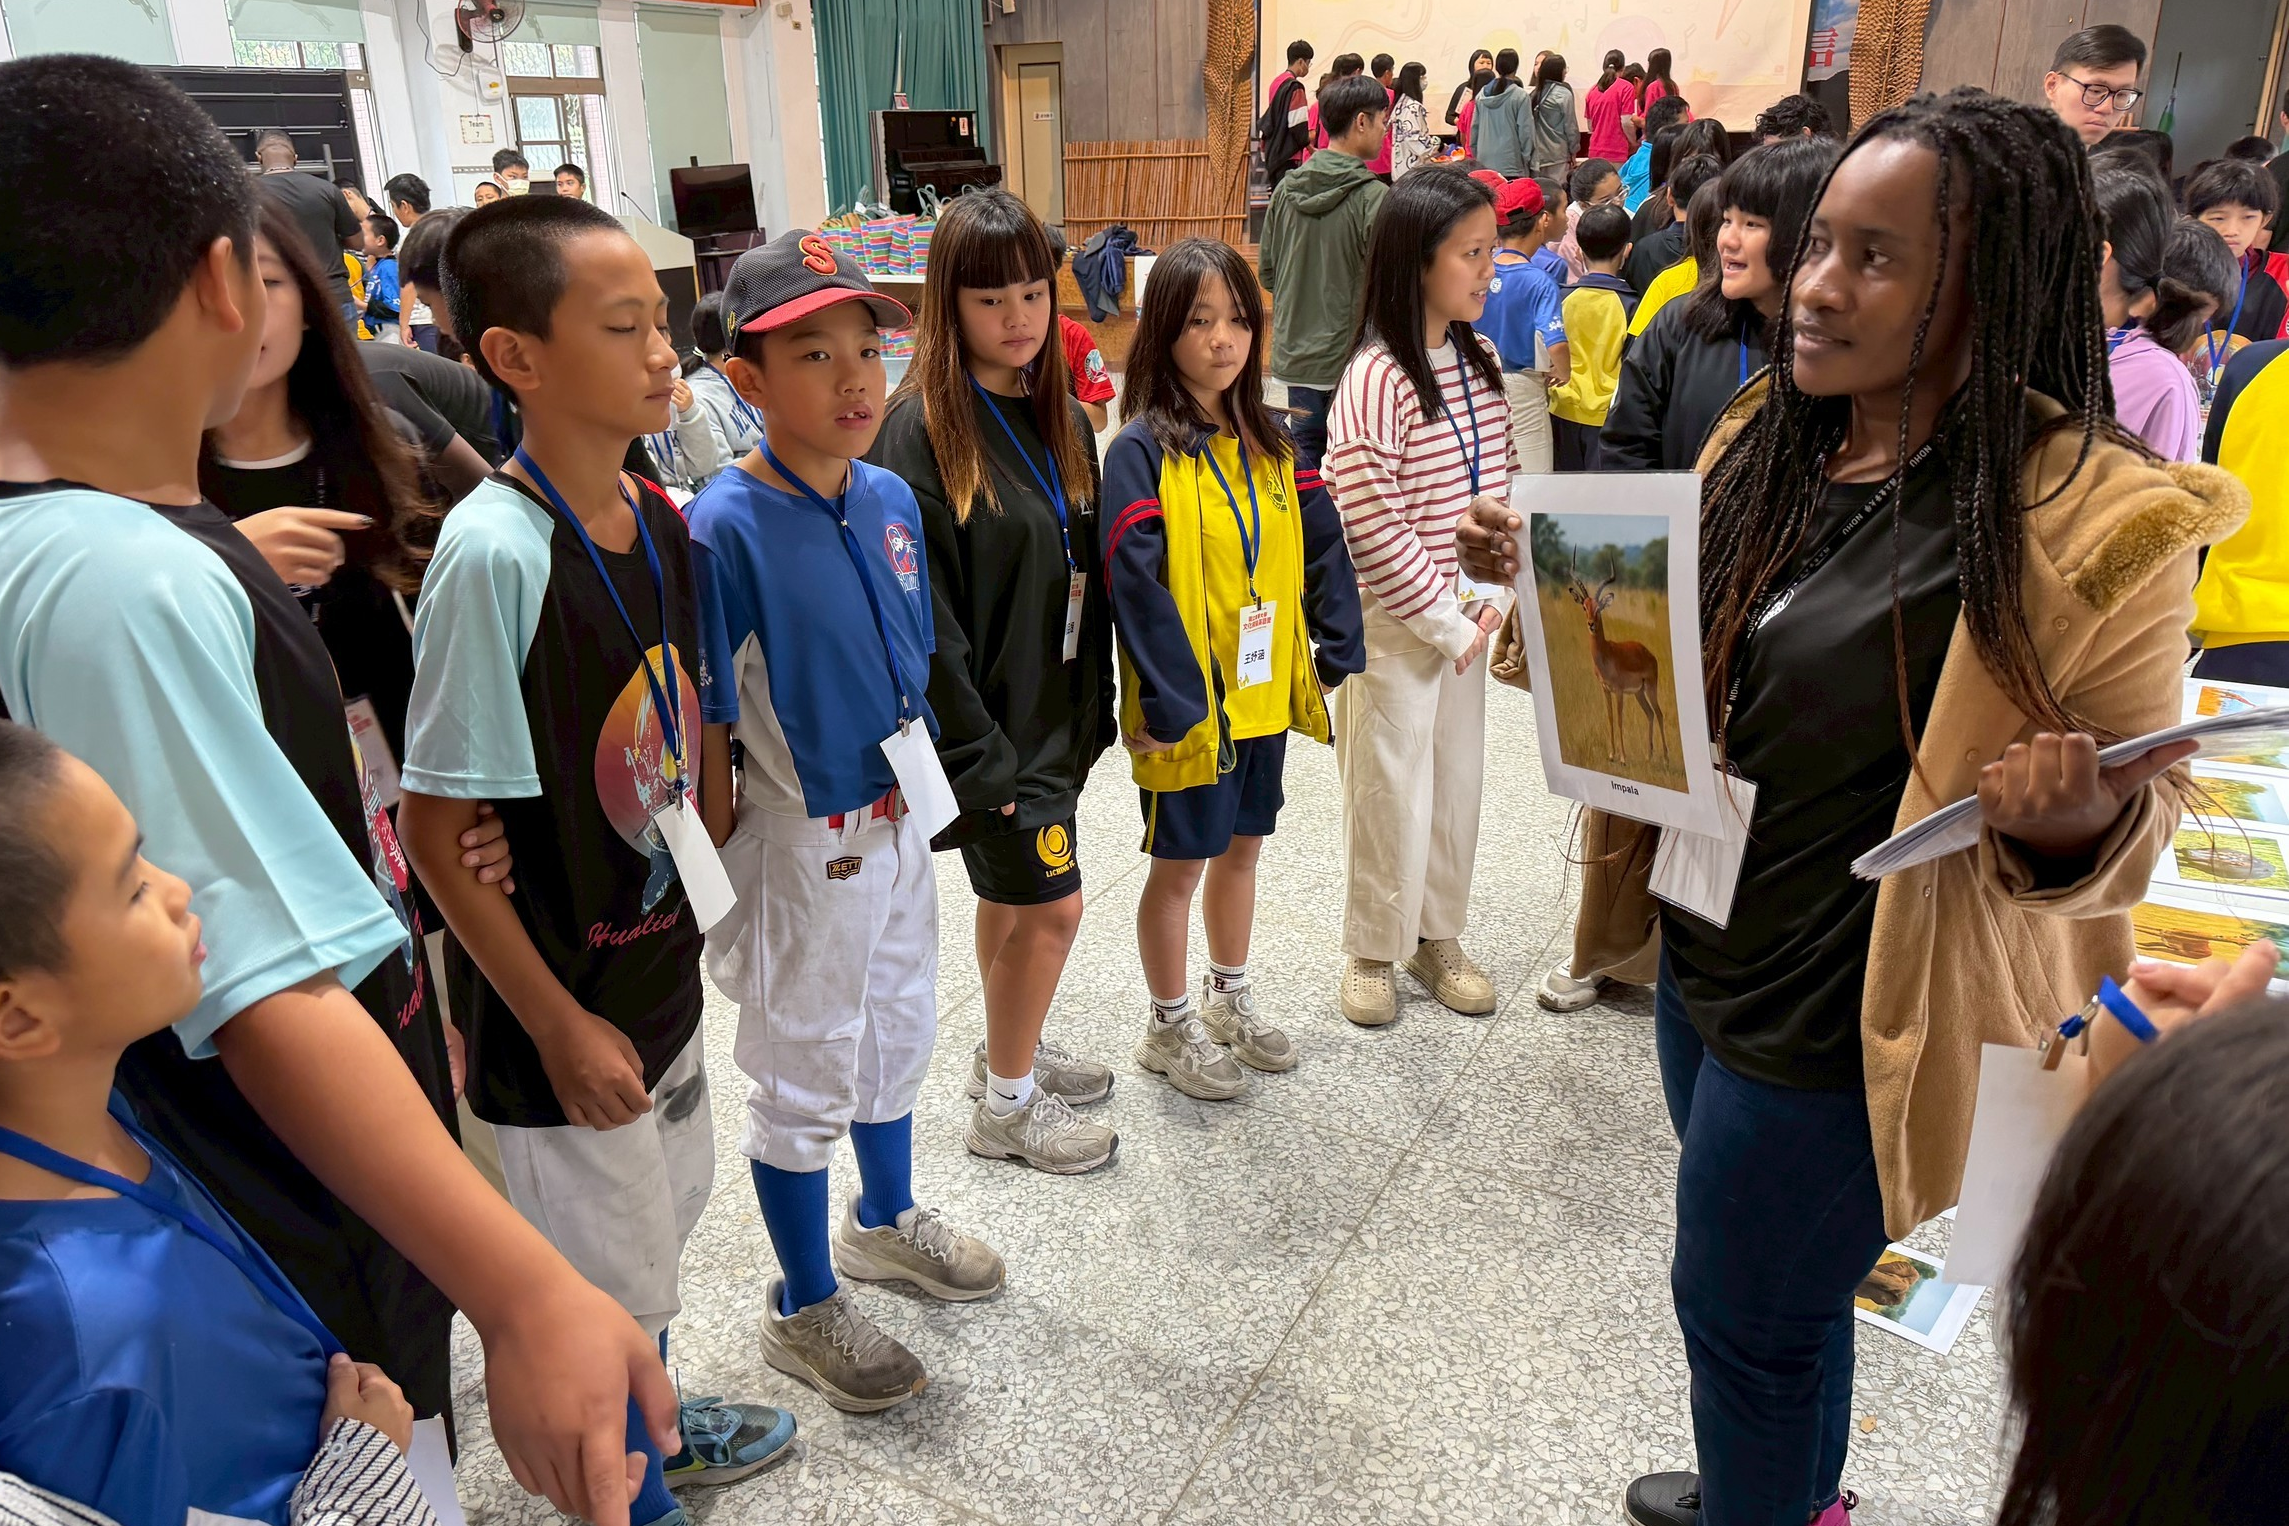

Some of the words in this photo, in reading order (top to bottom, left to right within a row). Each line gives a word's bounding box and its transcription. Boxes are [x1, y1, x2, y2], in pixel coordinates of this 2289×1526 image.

[799, 235, 838, 276] S
[1909, 444, 1933, 468] NDHU
[1842, 513, 1864, 535] NDHU
[1728, 677, 1741, 701] NDHU
[1611, 780, 1640, 795] Impala
[831, 860, 860, 873] ZETT
